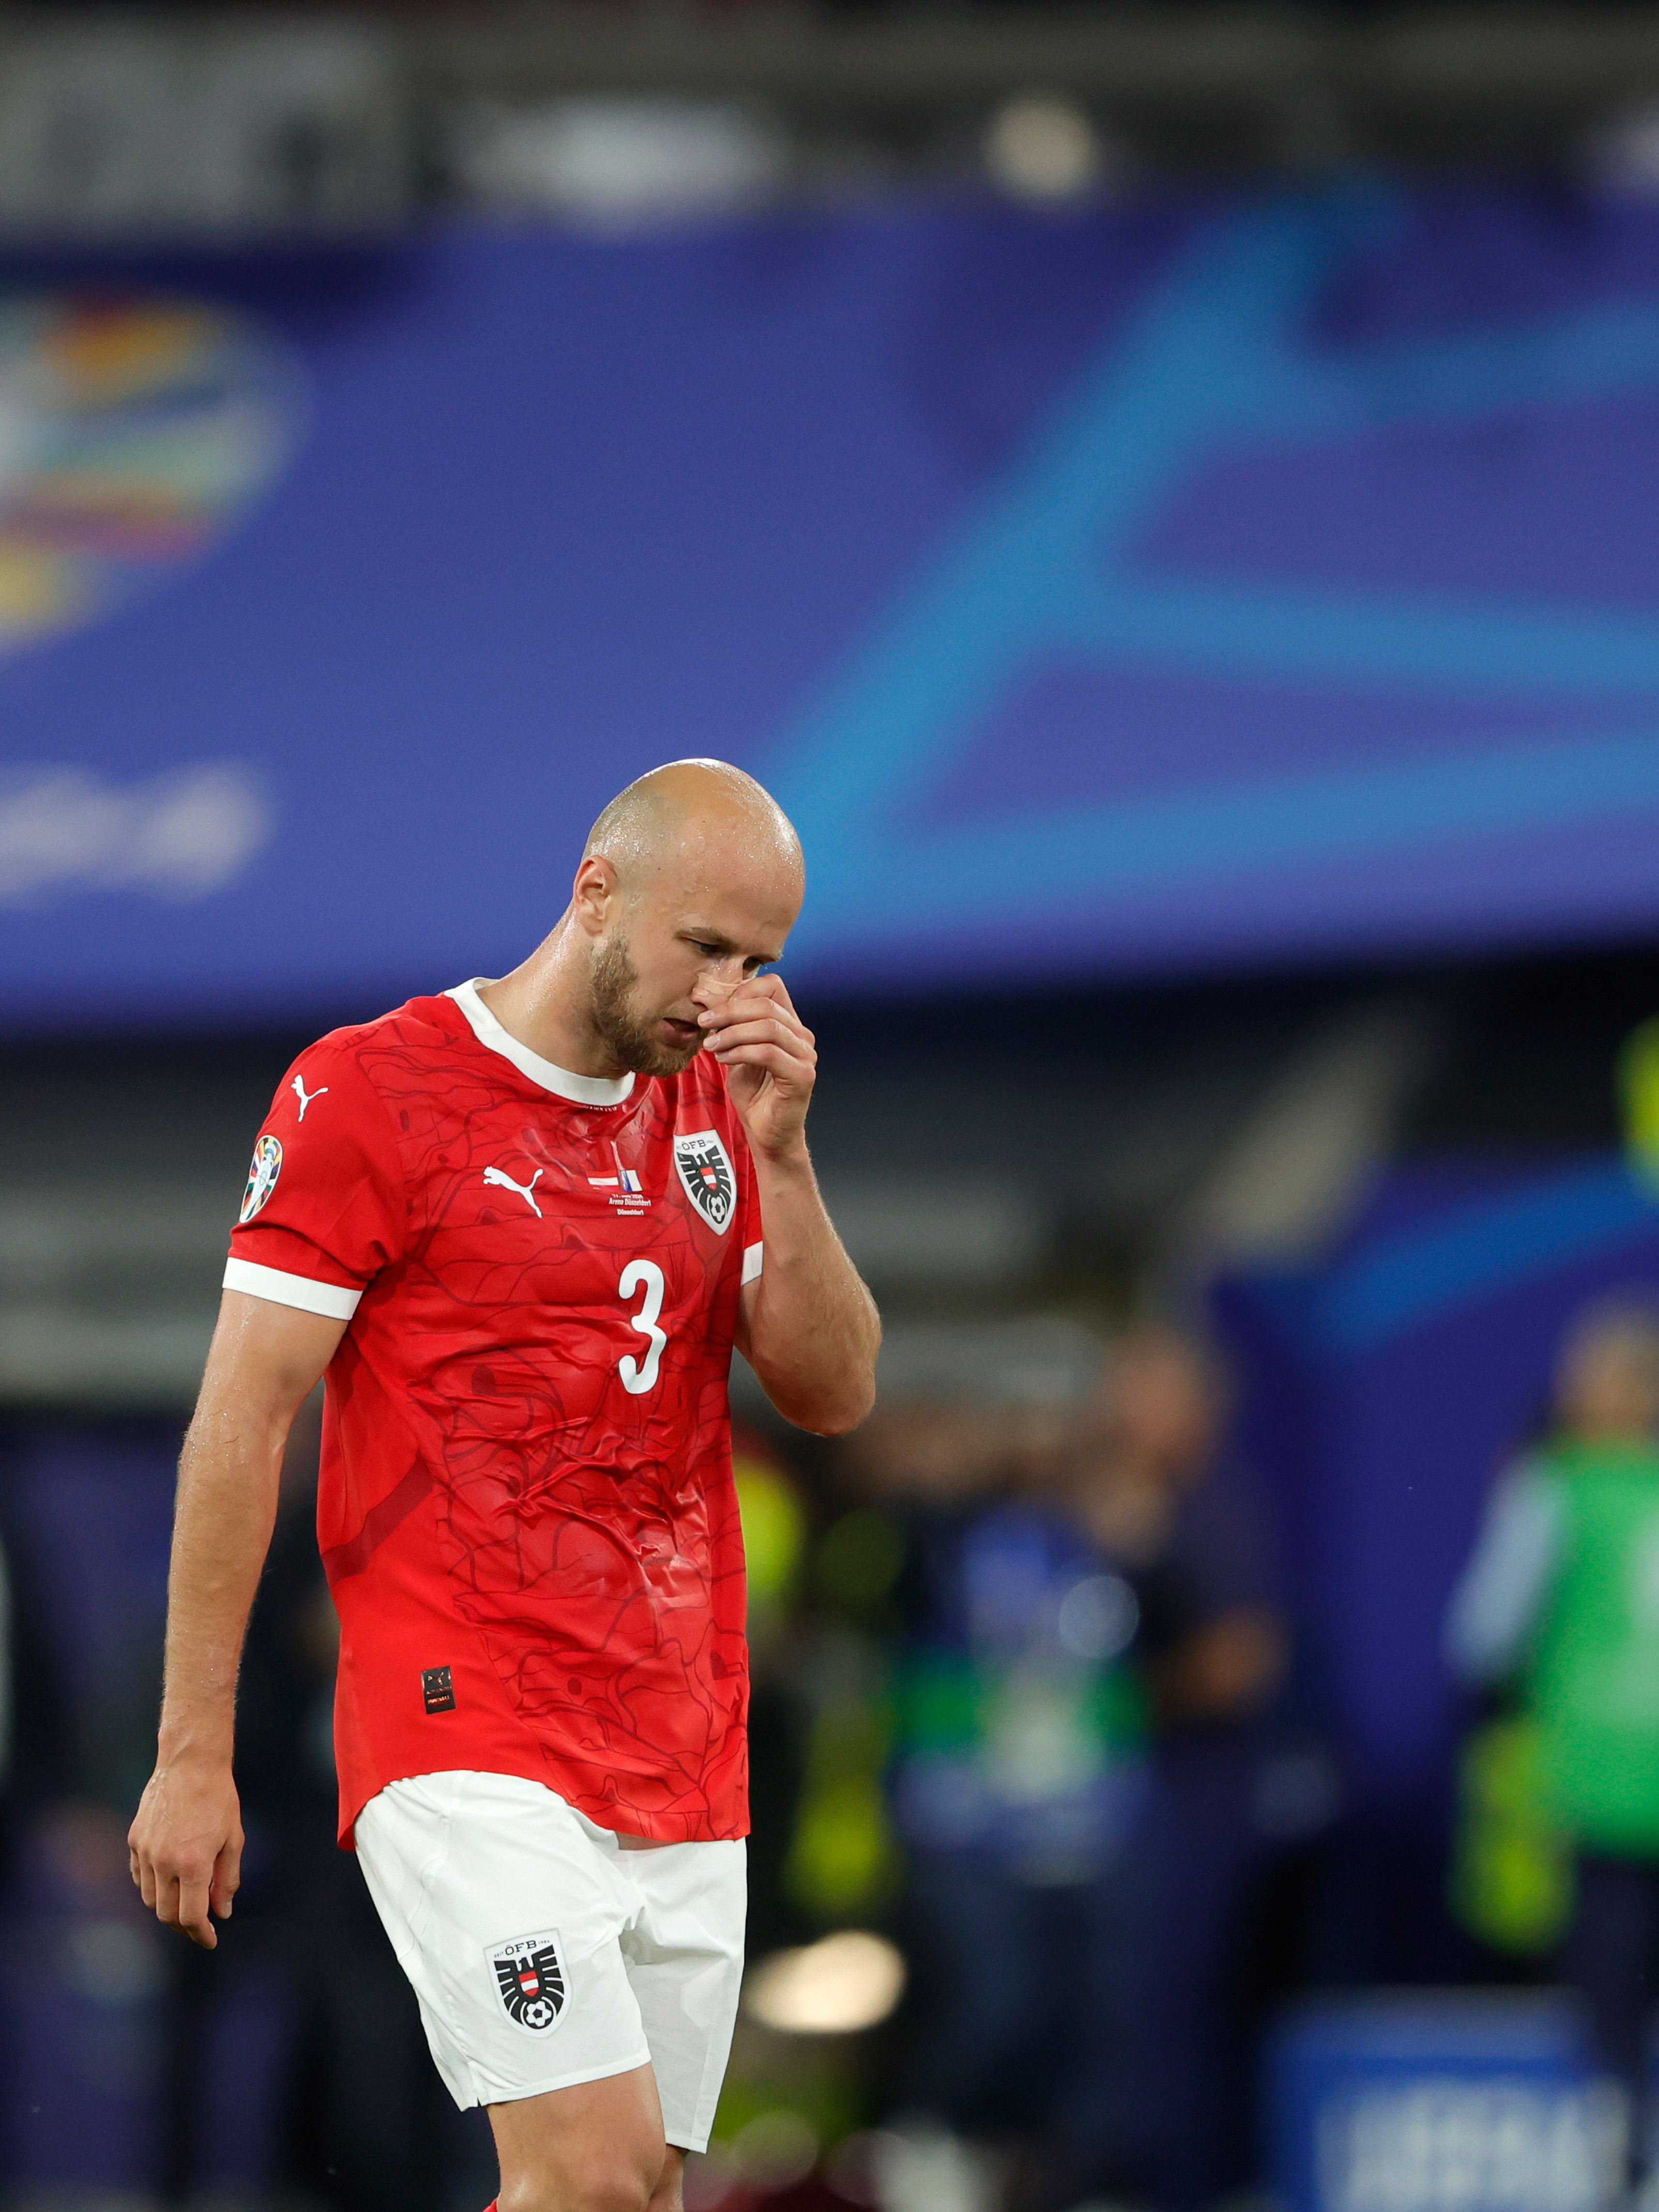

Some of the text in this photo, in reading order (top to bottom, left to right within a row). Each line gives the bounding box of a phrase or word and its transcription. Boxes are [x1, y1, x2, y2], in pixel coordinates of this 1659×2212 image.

[682, 1140, 706, 1150] ÖFB
[618, 1259, 668, 1394] 3
[505, 1940, 537, 1955] ÖFB
